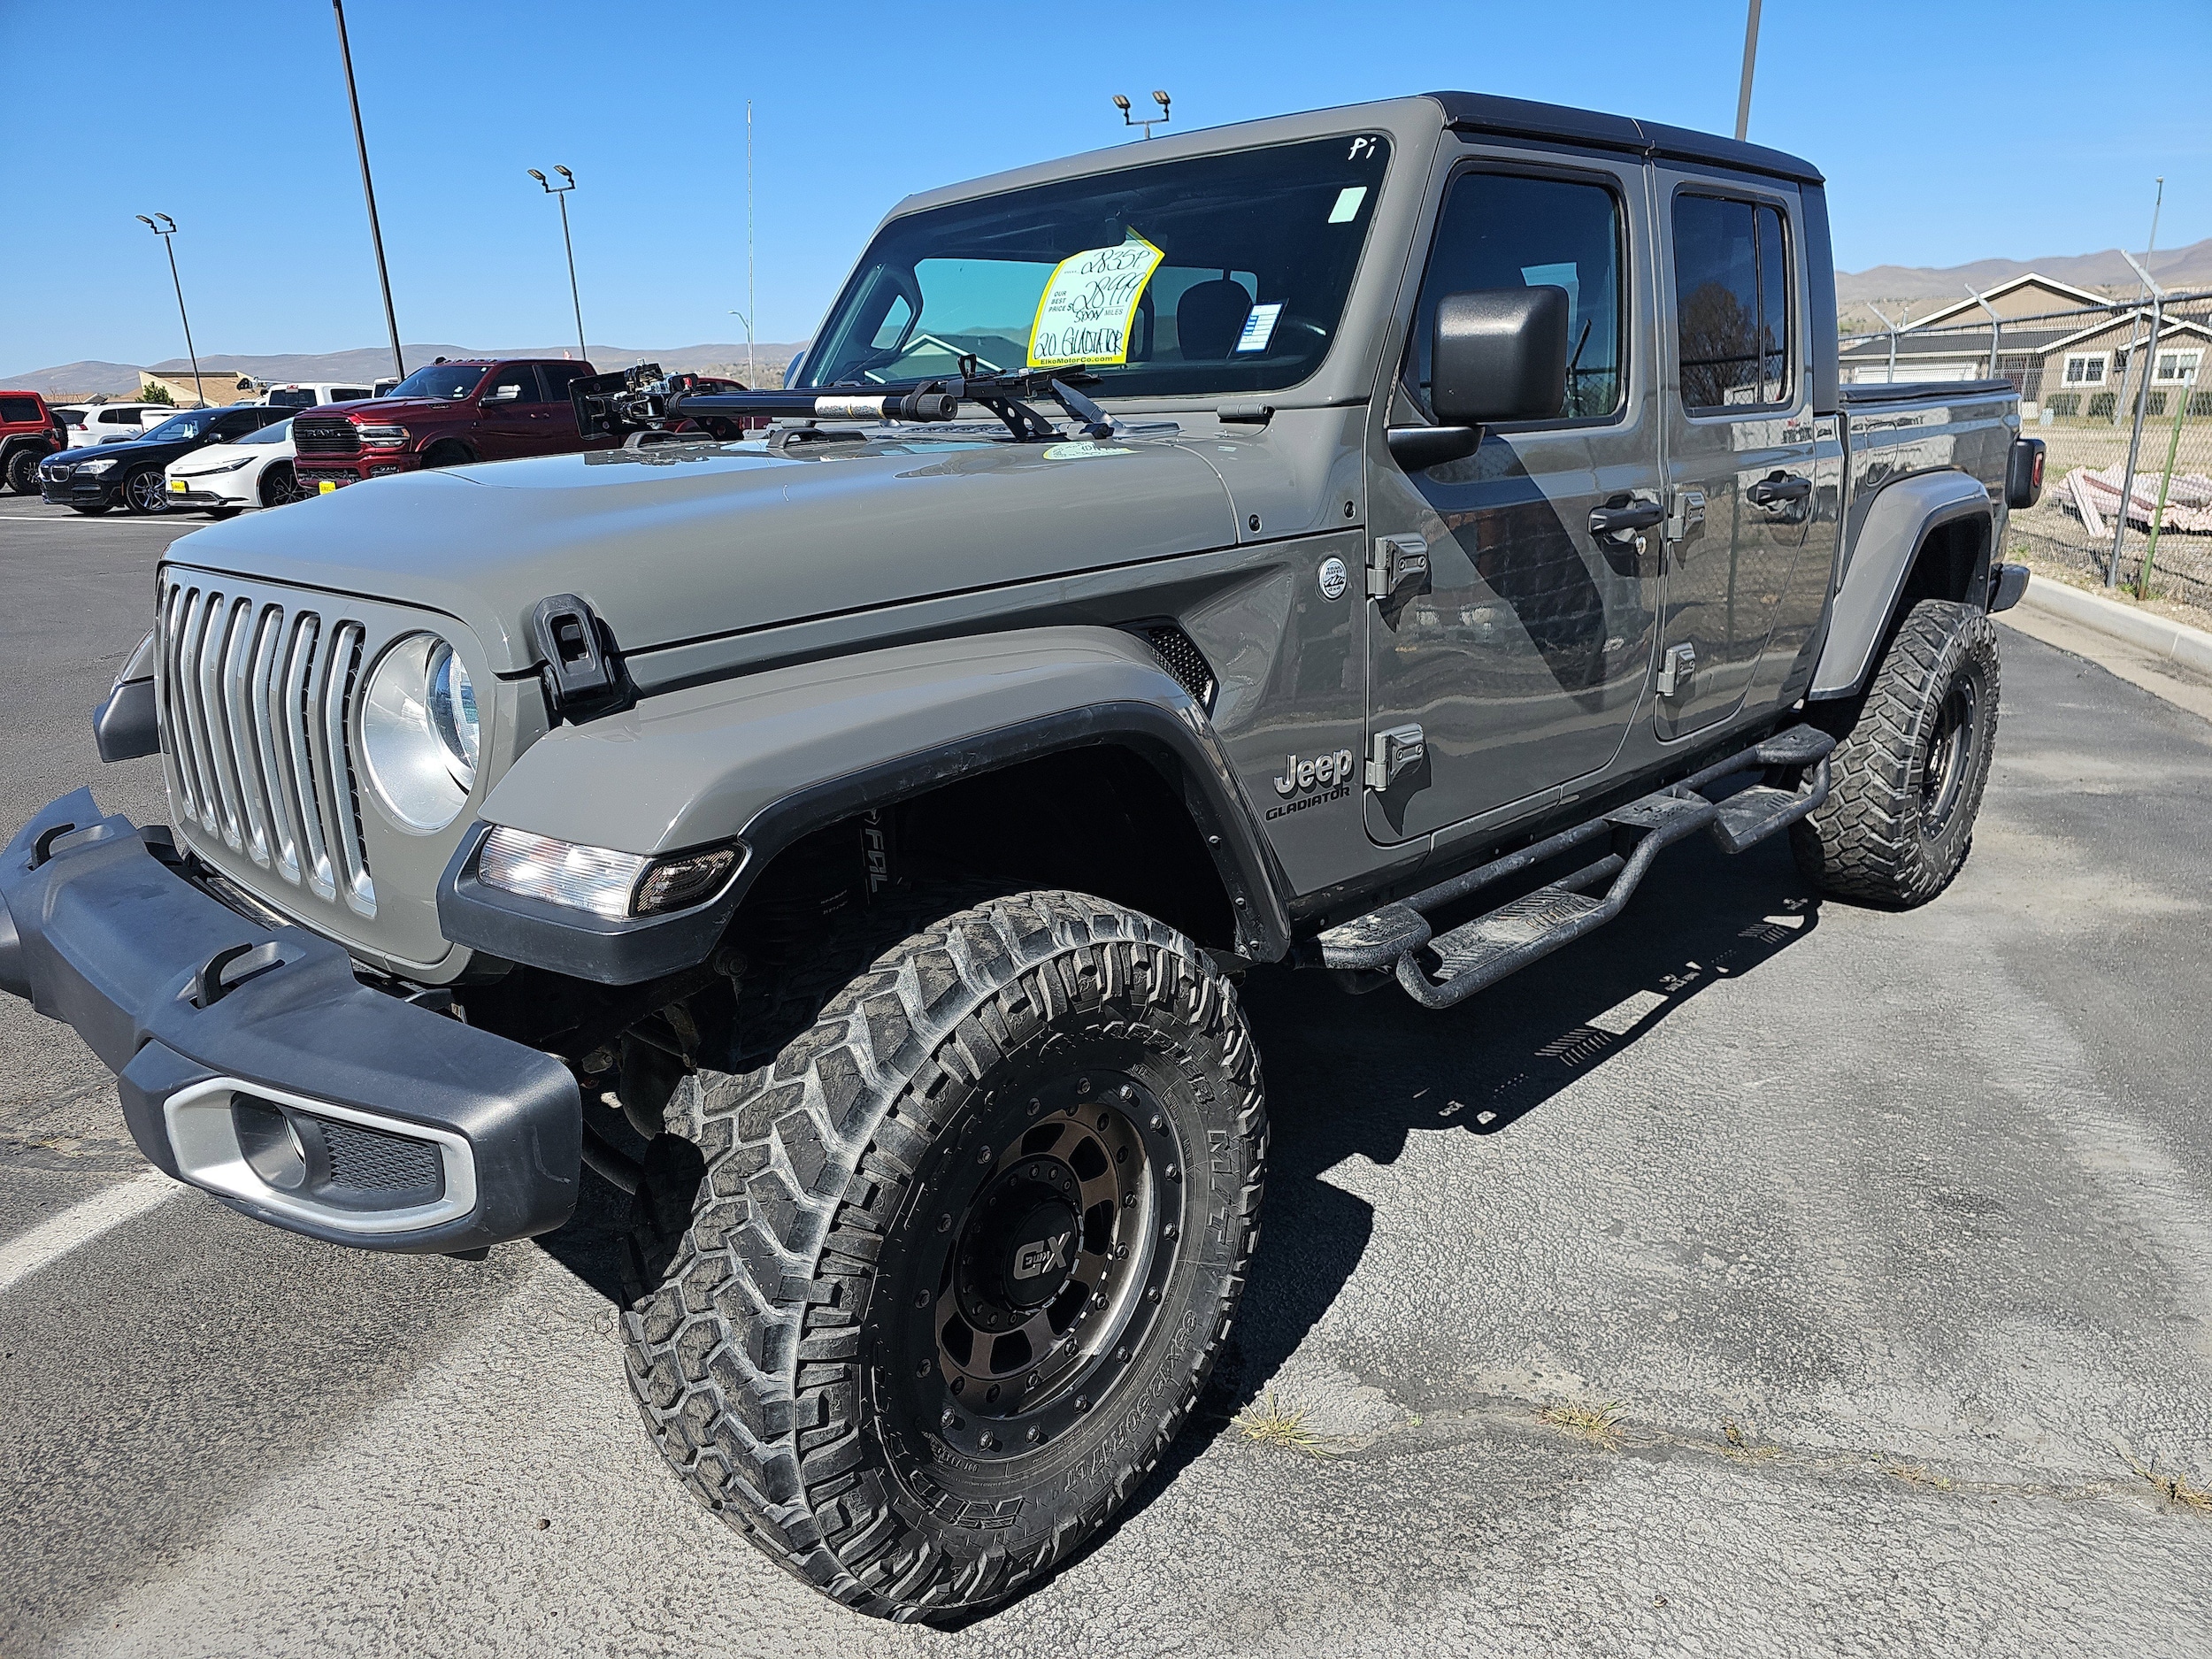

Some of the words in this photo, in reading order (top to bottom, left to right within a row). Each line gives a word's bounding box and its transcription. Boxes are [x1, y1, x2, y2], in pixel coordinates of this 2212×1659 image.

[1033, 332, 1056, 359] 20
[1040, 356, 1113, 365] ElkoMotorCo.com
[1274, 749, 1353, 793] Jeep
[1265, 787, 1350, 821] GLADIATOR
